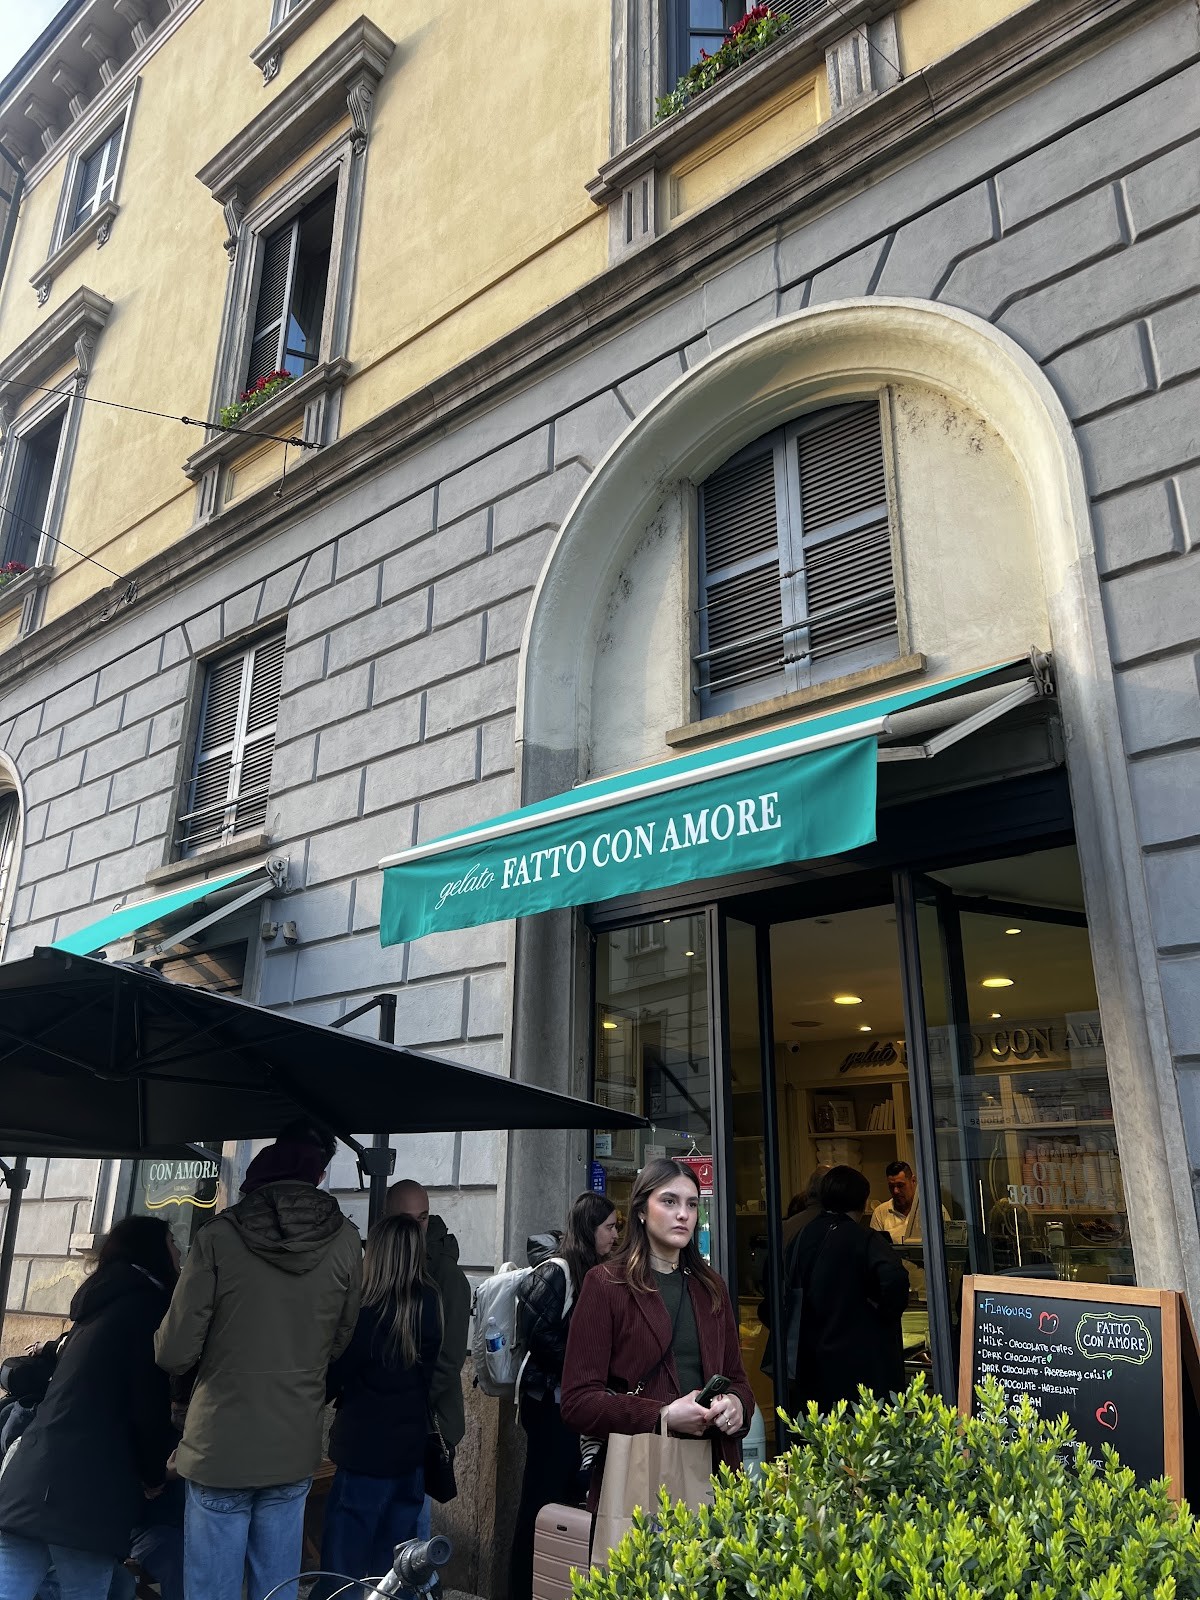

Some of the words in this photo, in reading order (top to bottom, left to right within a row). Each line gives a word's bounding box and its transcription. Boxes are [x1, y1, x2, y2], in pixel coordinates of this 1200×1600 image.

[435, 863, 496, 910] gelato
[501, 840, 587, 890] FATTO
[592, 821, 656, 867] CON
[660, 792, 782, 853] AMORE
[991, 1026, 1053, 1057] CON
[149, 1162, 172, 1181] CON
[174, 1160, 219, 1180] AMORE
[1096, 1321, 1131, 1336] FATTO
[1082, 1334, 1104, 1347] CON
[1107, 1336, 1146, 1352] AMORE
[981, 1348, 1003, 1360] DARK
[1004, 1351, 1047, 1364] CHOCOLATE
[981, 1363, 1000, 1374] DARK
